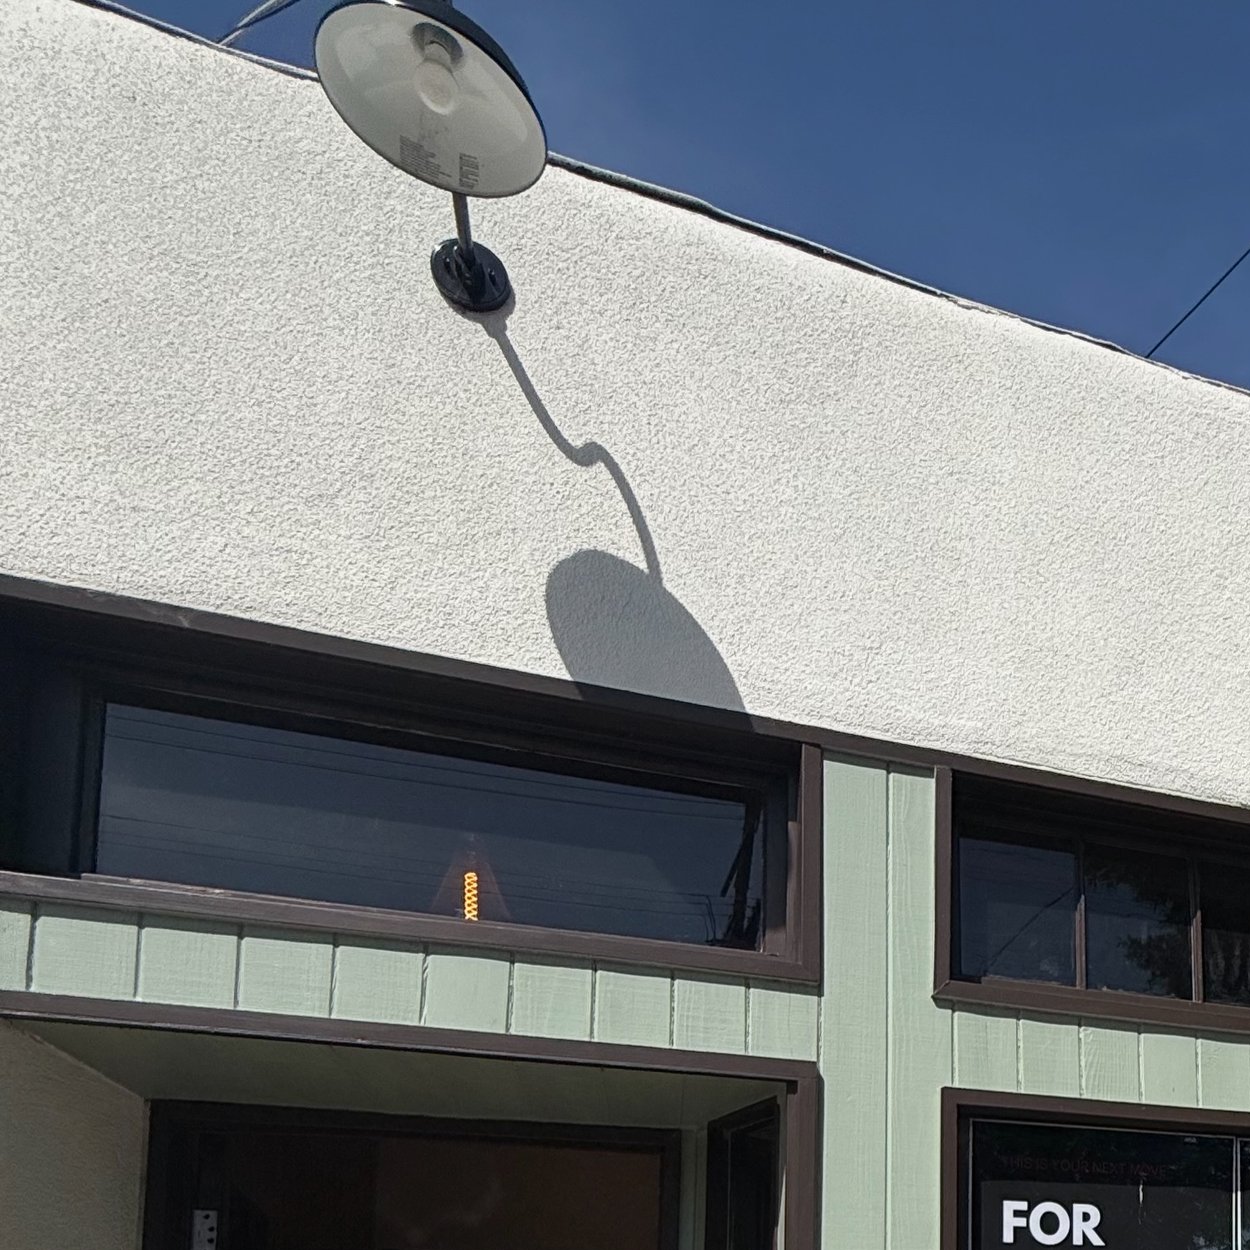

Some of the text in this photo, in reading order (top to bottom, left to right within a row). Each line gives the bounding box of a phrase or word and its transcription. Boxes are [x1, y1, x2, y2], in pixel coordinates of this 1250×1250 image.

[1052, 1158, 1090, 1172] YOUR
[1092, 1161, 1126, 1174] NEXT
[1002, 1200, 1105, 1246] FOR
